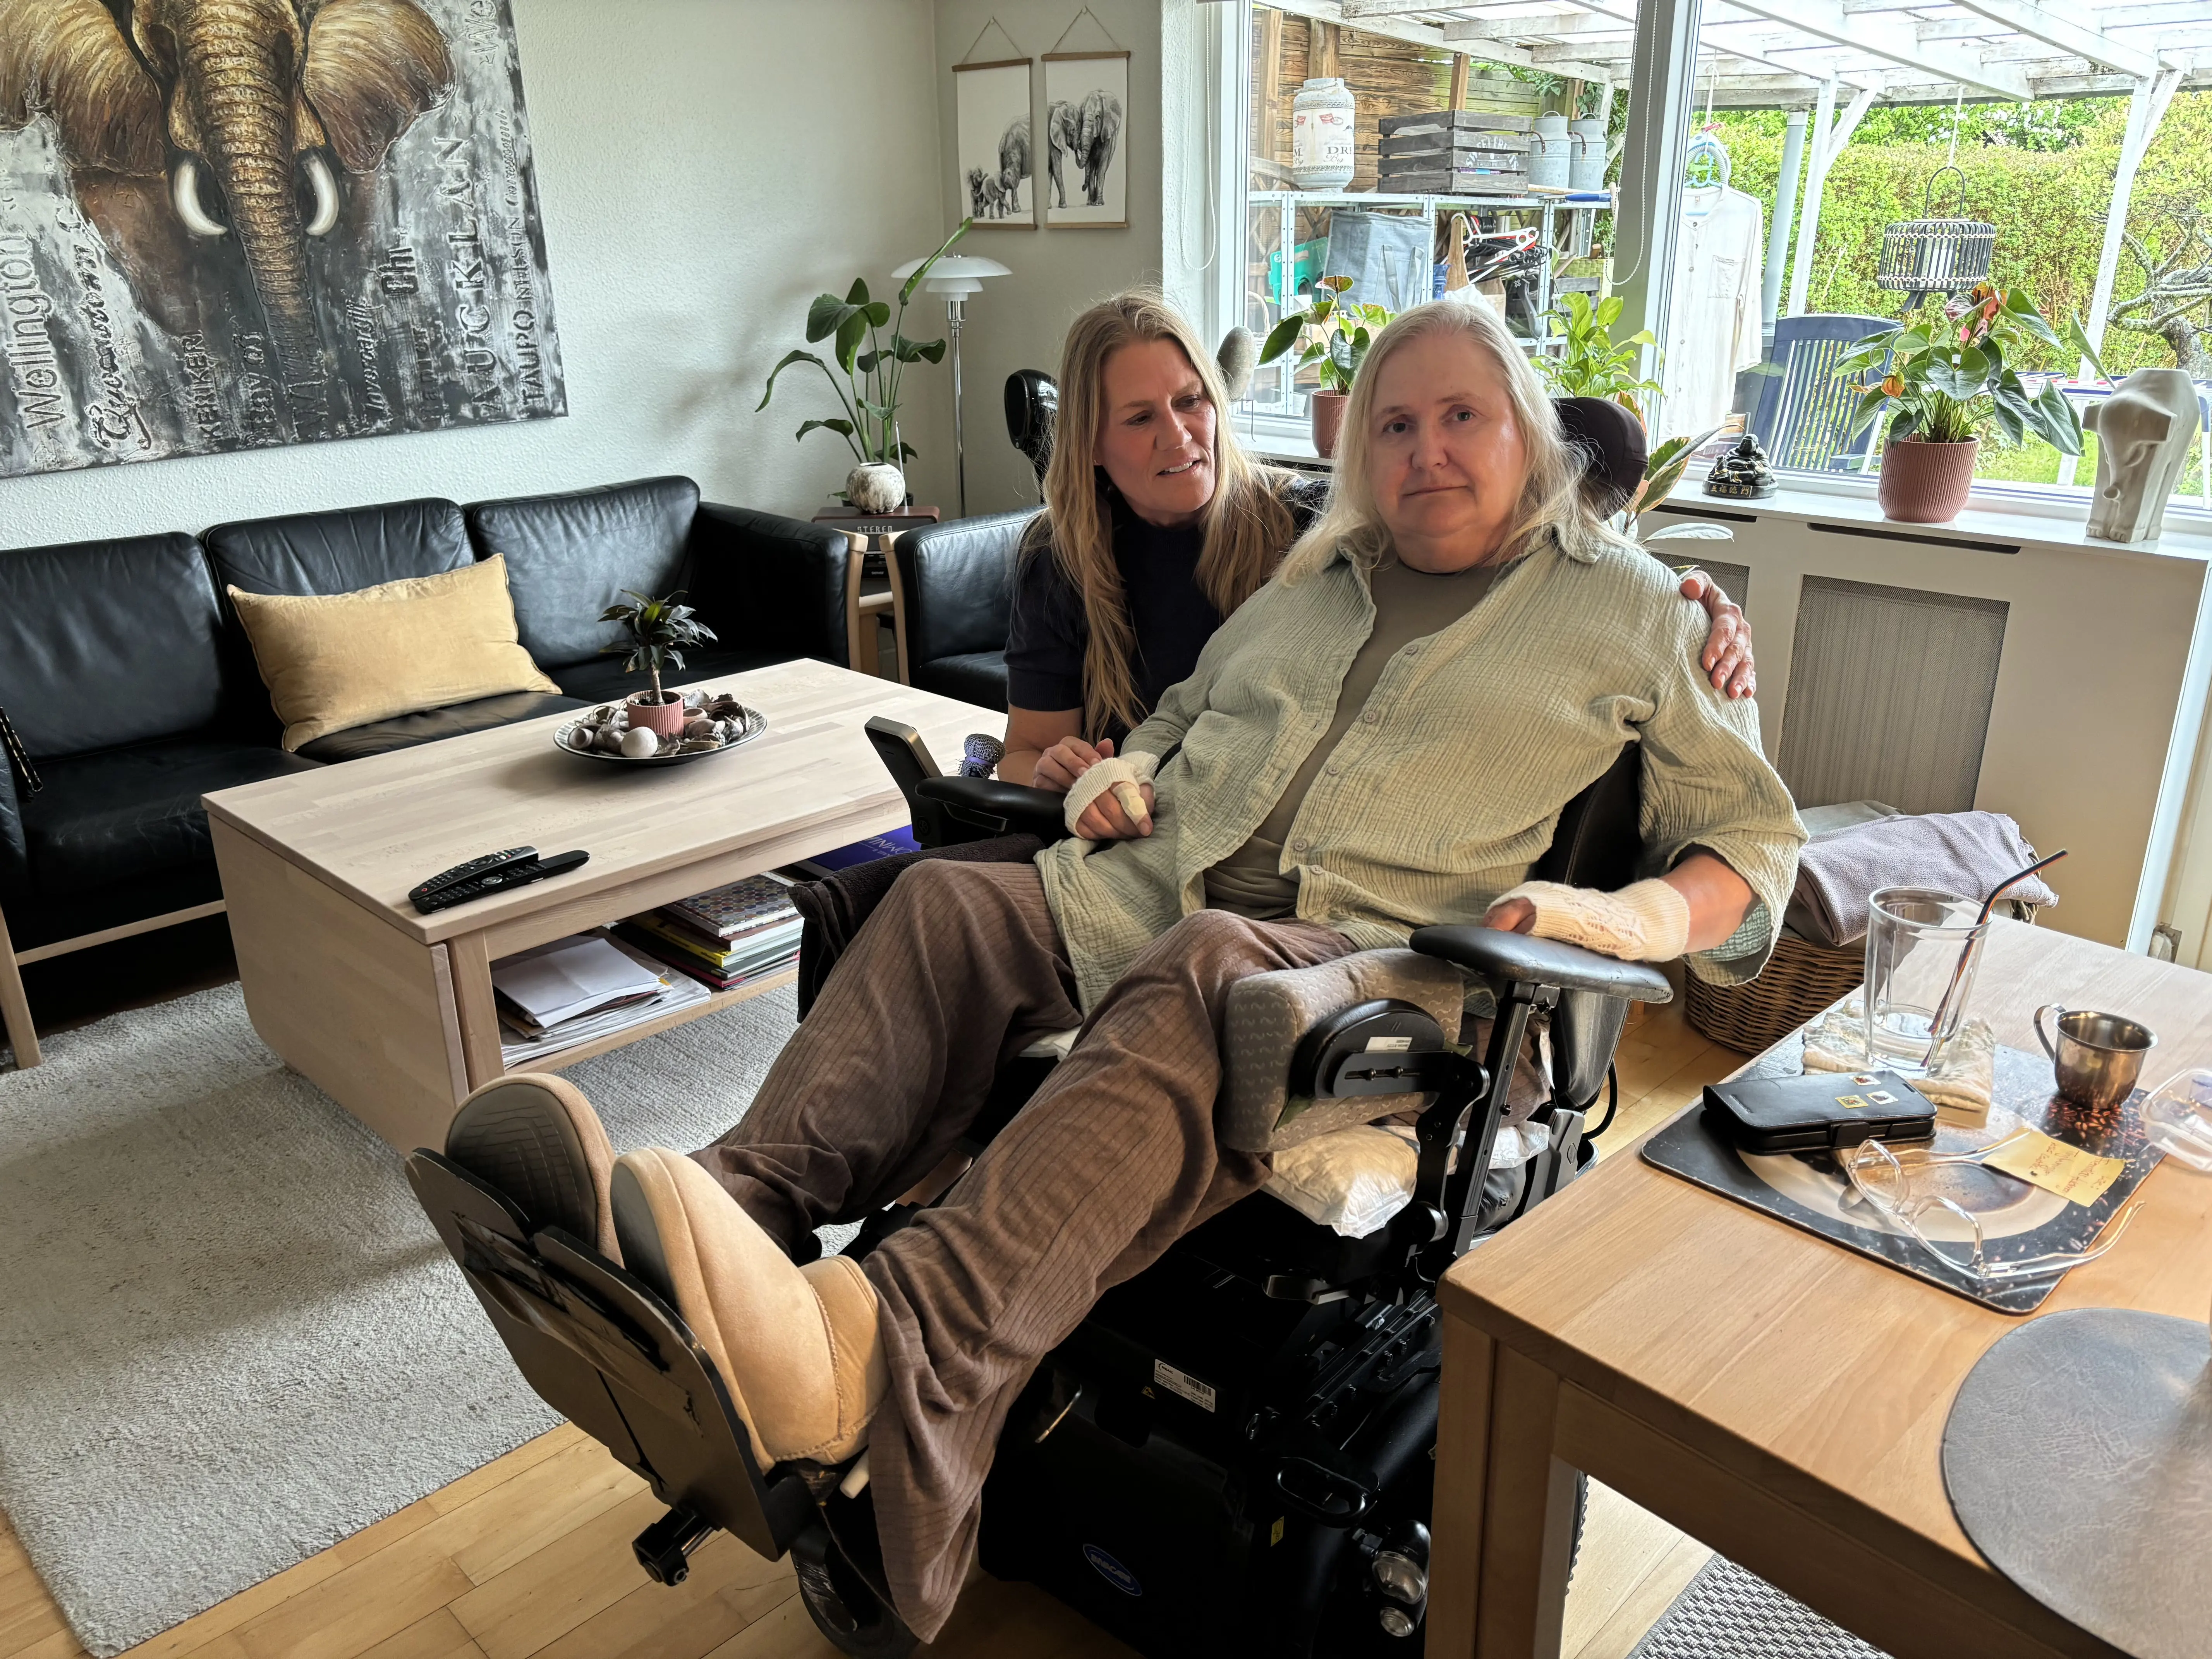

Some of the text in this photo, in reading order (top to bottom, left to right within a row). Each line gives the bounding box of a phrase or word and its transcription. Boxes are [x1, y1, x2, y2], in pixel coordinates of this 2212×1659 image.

[0, 234, 66, 429] Wellington
[512, 309, 544, 407] TAUPO
[857, 526, 893, 534] STEREO
